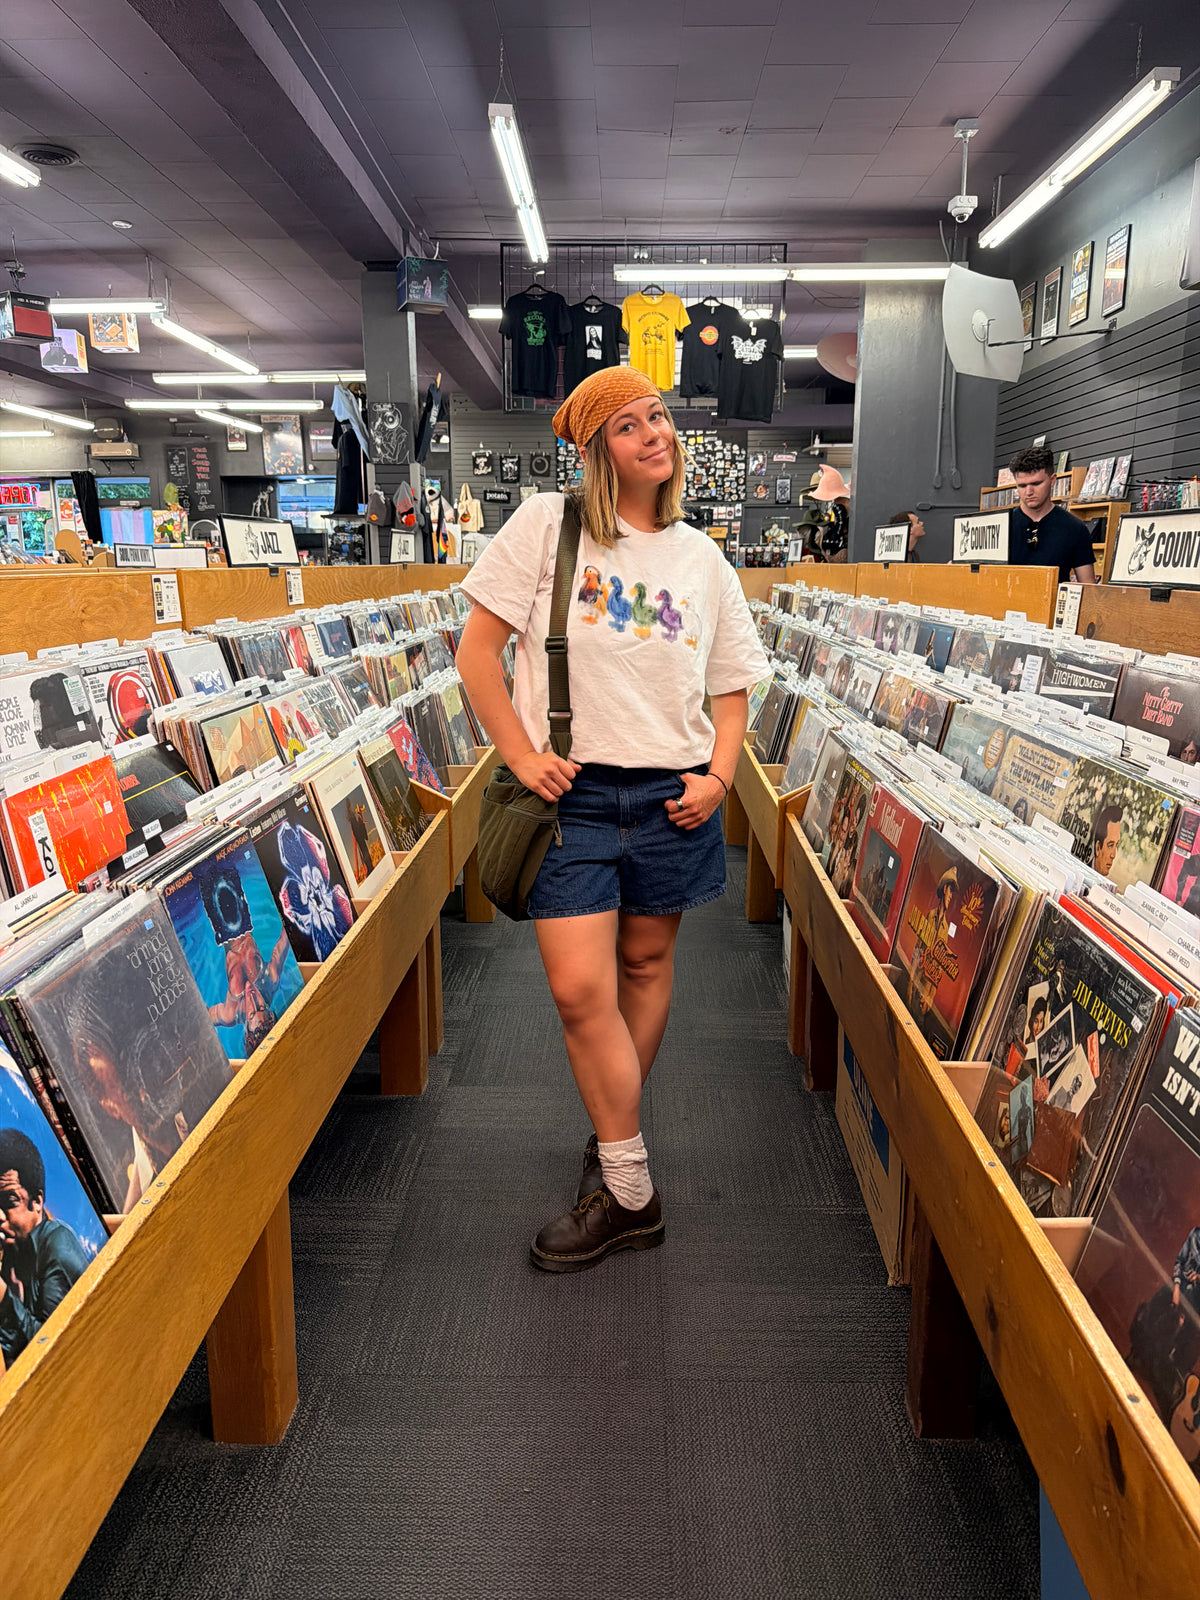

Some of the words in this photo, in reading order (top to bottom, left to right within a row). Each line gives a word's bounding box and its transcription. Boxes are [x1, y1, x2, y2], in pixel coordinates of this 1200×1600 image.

[486, 492, 508, 500] potato
[260, 531, 282, 554] JAZZ
[884, 534, 903, 552] COUNTRY
[970, 524, 1001, 550] COUNTRY
[1055, 661, 1068, 670] THE
[1051, 668, 1108, 690] HIGHWOMEN
[4, 708, 23, 721] LOVE
[1142, 692, 1162, 710] NITTY
[1160, 697, 1184, 716] GRITTY
[3, 720, 30, 737] JOHNNY
[1141, 708, 1158, 722] DIRT
[1157, 712, 1175, 728] BAND
[6, 733, 26, 748] LYTLE
[1009, 761, 1024, 778] THE
[1022, 768, 1057, 797] OUTLAWS
[1070, 812, 1090, 839] Price
[165, 884, 176, 898] JOHN
[175, 871, 194, 890] KLEMMER
[1108, 901, 1122, 916] REEVES
[1141, 900, 1156, 914] JEANNIE
[1158, 911, 1169, 922] RILEY
[1177, 936, 1195, 955] CHARLIE
[931, 938, 960, 982] California
[1166, 947, 1180, 961] JERRY
[1178, 956, 1191, 969] REED
[1073, 980, 1093, 1011] JIM
[1089, 995, 1132, 1049] REEVES
